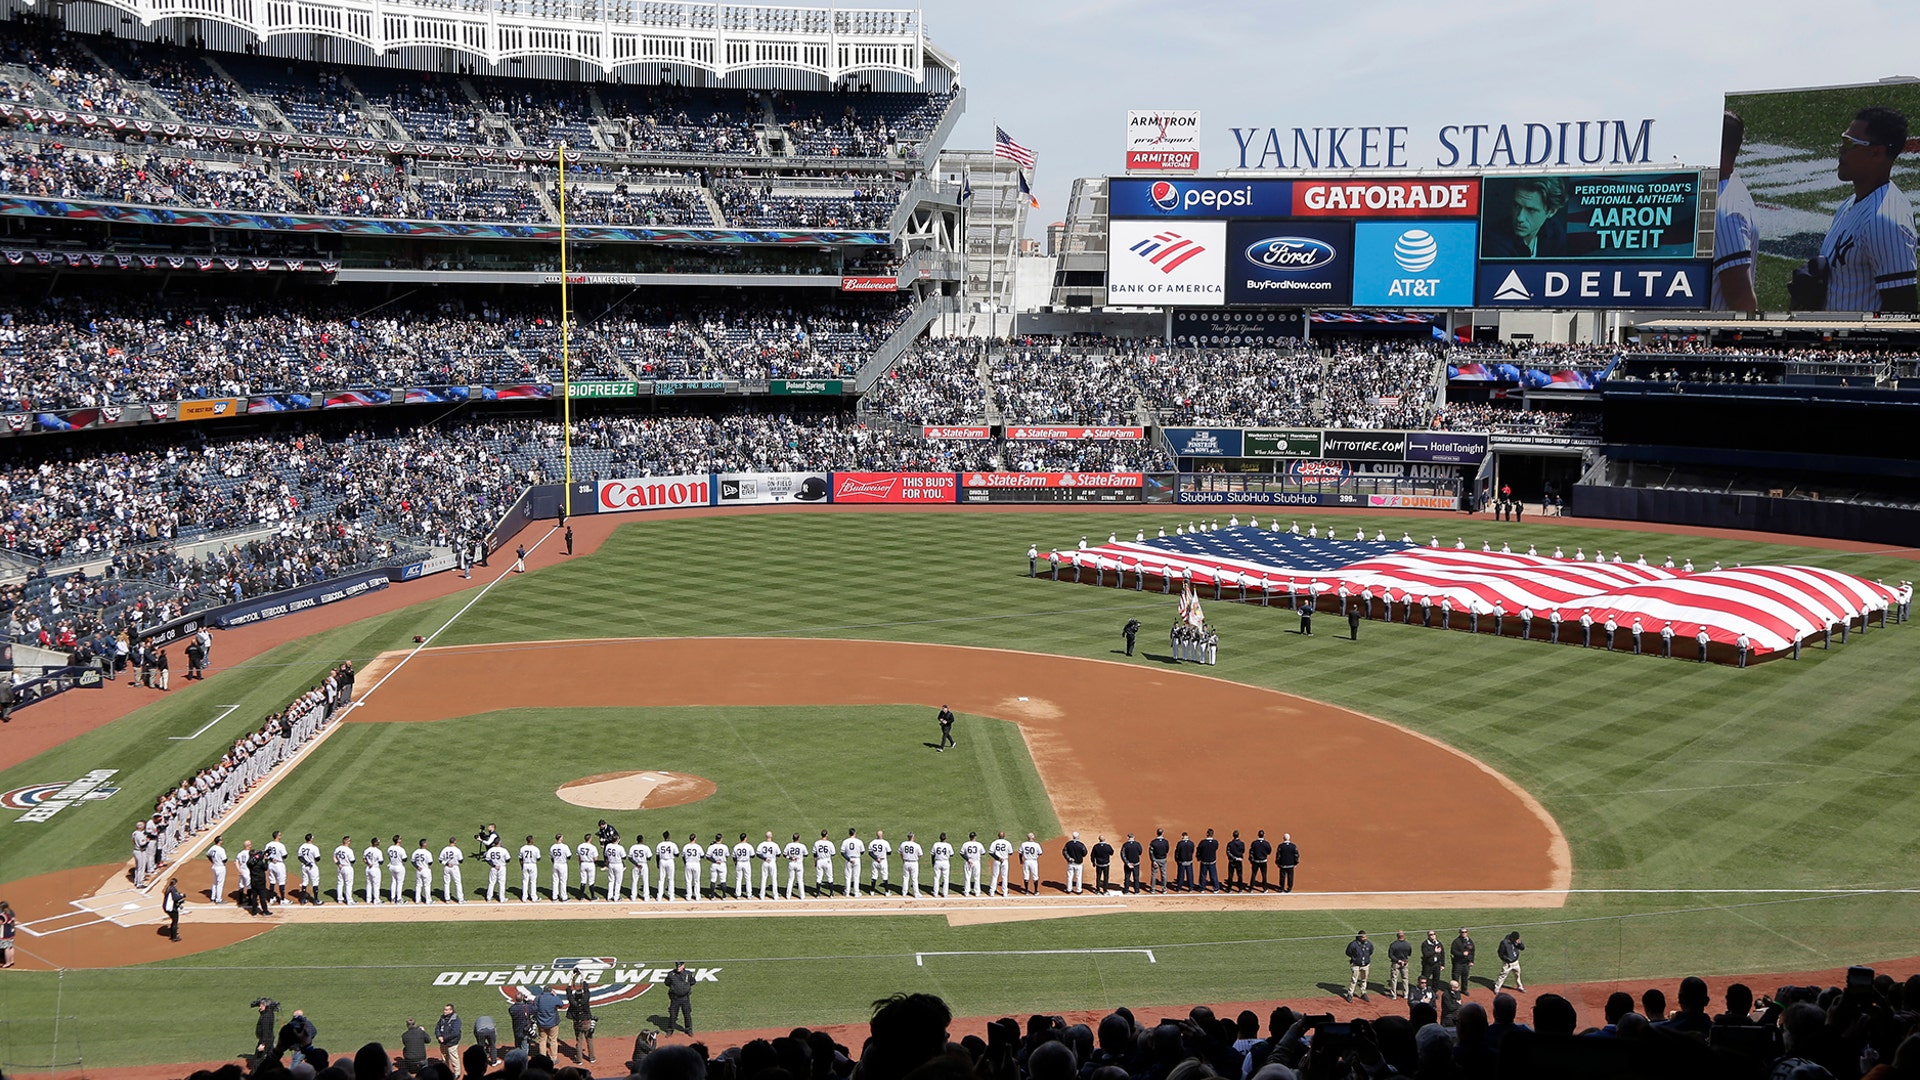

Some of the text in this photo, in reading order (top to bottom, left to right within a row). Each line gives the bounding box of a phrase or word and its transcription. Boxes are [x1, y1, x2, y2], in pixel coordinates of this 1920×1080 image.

[1131, 117, 1196, 126] ARMITRON
[1229, 119, 1656, 169] YANKEE STADIUM
[1133, 153, 1193, 162] ARMITRON
[1575, 183, 1692, 195] PERFORMING TODAY'S
[1184, 185, 1252, 210] pepsi
[1303, 185, 1468, 210] GATORADE
[1580, 193, 1685, 205] NATIONAL ANTHEM:
[1589, 206, 1672, 227] AARON
[1597, 229, 1664, 249] TVEIT
[1263, 241, 1318, 264] Ford
[588, 275, 618, 283] YANKEES
[619, 275, 637, 283] CLUB
[843, 279, 896, 290] Budweiser
[1111, 284, 1222, 293] BANK OF AMERICA
[1247, 279, 1332, 290] BuyFordNow.com
[1387, 279, 1440, 297] AT&T
[1544, 271, 1694, 297] DELTA
[1298, 459, 1343, 472] Jersey
[902, 477, 954, 487] THIS BUD'S
[842, 482, 891, 492] Budweiser
[600, 481, 709, 508] Canon
[902, 489, 944, 498] FOR YOU.
[1181, 492, 1223, 502] StubHub
[1227, 492, 1270, 503] StubHub
[1273, 493, 1317, 504] StubHub
[1402, 496, 1455, 508] DUNKIN'
[660, 846, 671, 854] 54
[762, 846, 773, 854] 34
[818, 845, 829, 853] 26
[849, 842, 854, 850] 0
[872, 844, 882, 852] 59
[967, 846, 977, 854] 63
[995, 843, 1006, 851] 62
[301, 848, 310, 856] 27
[389, 850, 398, 859] 33
[445, 851, 454, 859] 12
[525, 850, 532, 858] 71
[552, 849, 562, 857] 65
[580, 848, 590, 856] 57
[633, 850, 644, 858] 55
[686, 848, 697, 856] 53
[712, 848, 723, 856] 48
[737, 848, 747, 856] 39
[790, 847, 800, 855] 28
[936, 847, 947, 855] 64
[1025, 847, 1035, 855] 50
[432, 967, 723, 985] OPENING WEK
